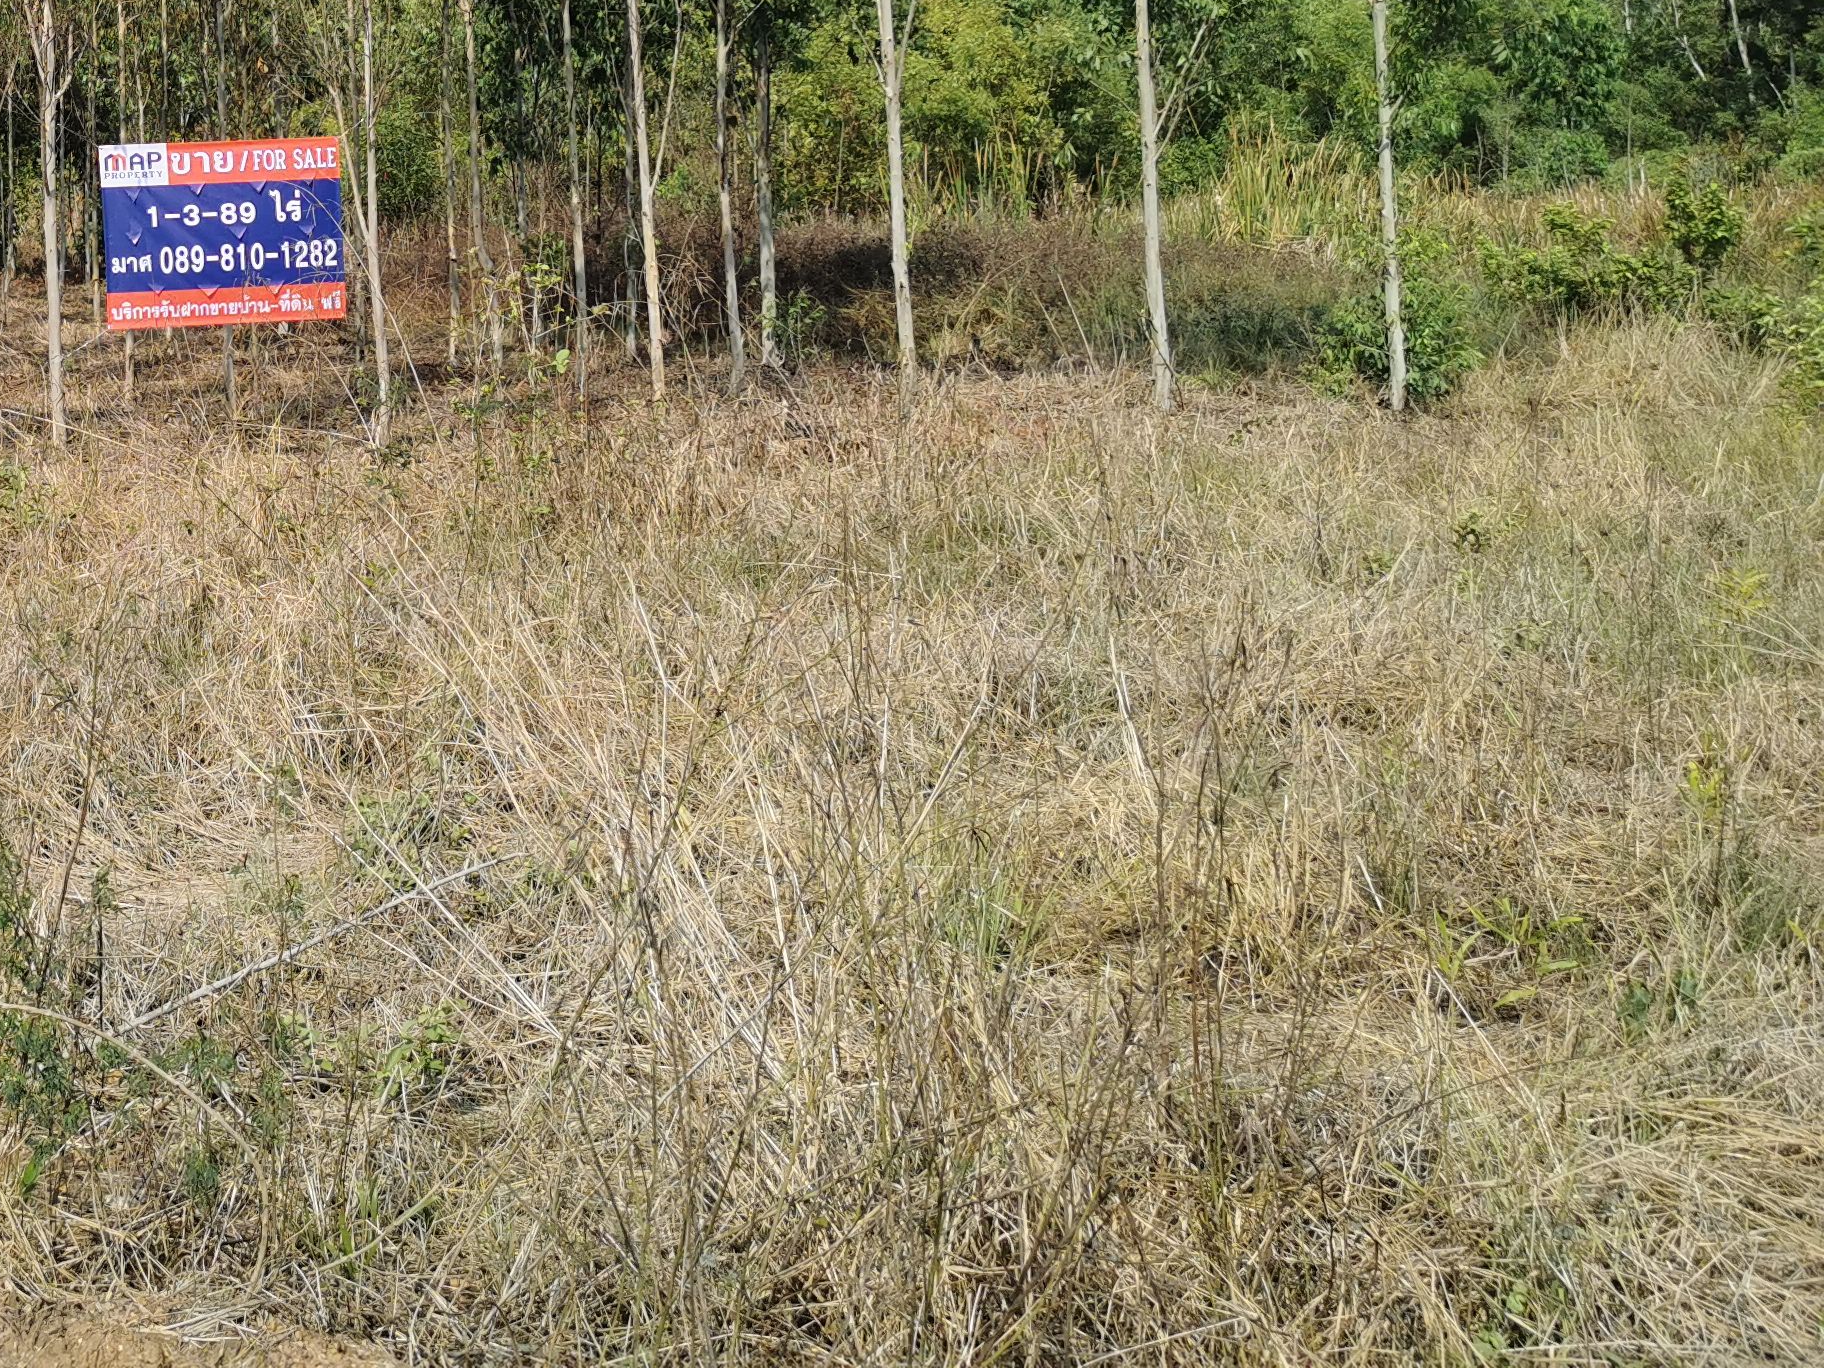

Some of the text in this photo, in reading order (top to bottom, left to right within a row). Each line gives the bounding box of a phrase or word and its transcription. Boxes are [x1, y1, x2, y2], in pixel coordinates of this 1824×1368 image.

[104, 151, 162, 171] MAP
[104, 170, 163, 179] PROPERTY
[170, 150, 234, 175] ขาย
[293, 147, 337, 169] SALE
[147, 188, 302, 228] 1-3-89 ไร่
[111, 239, 338, 274] มาศ 089-810-1282
